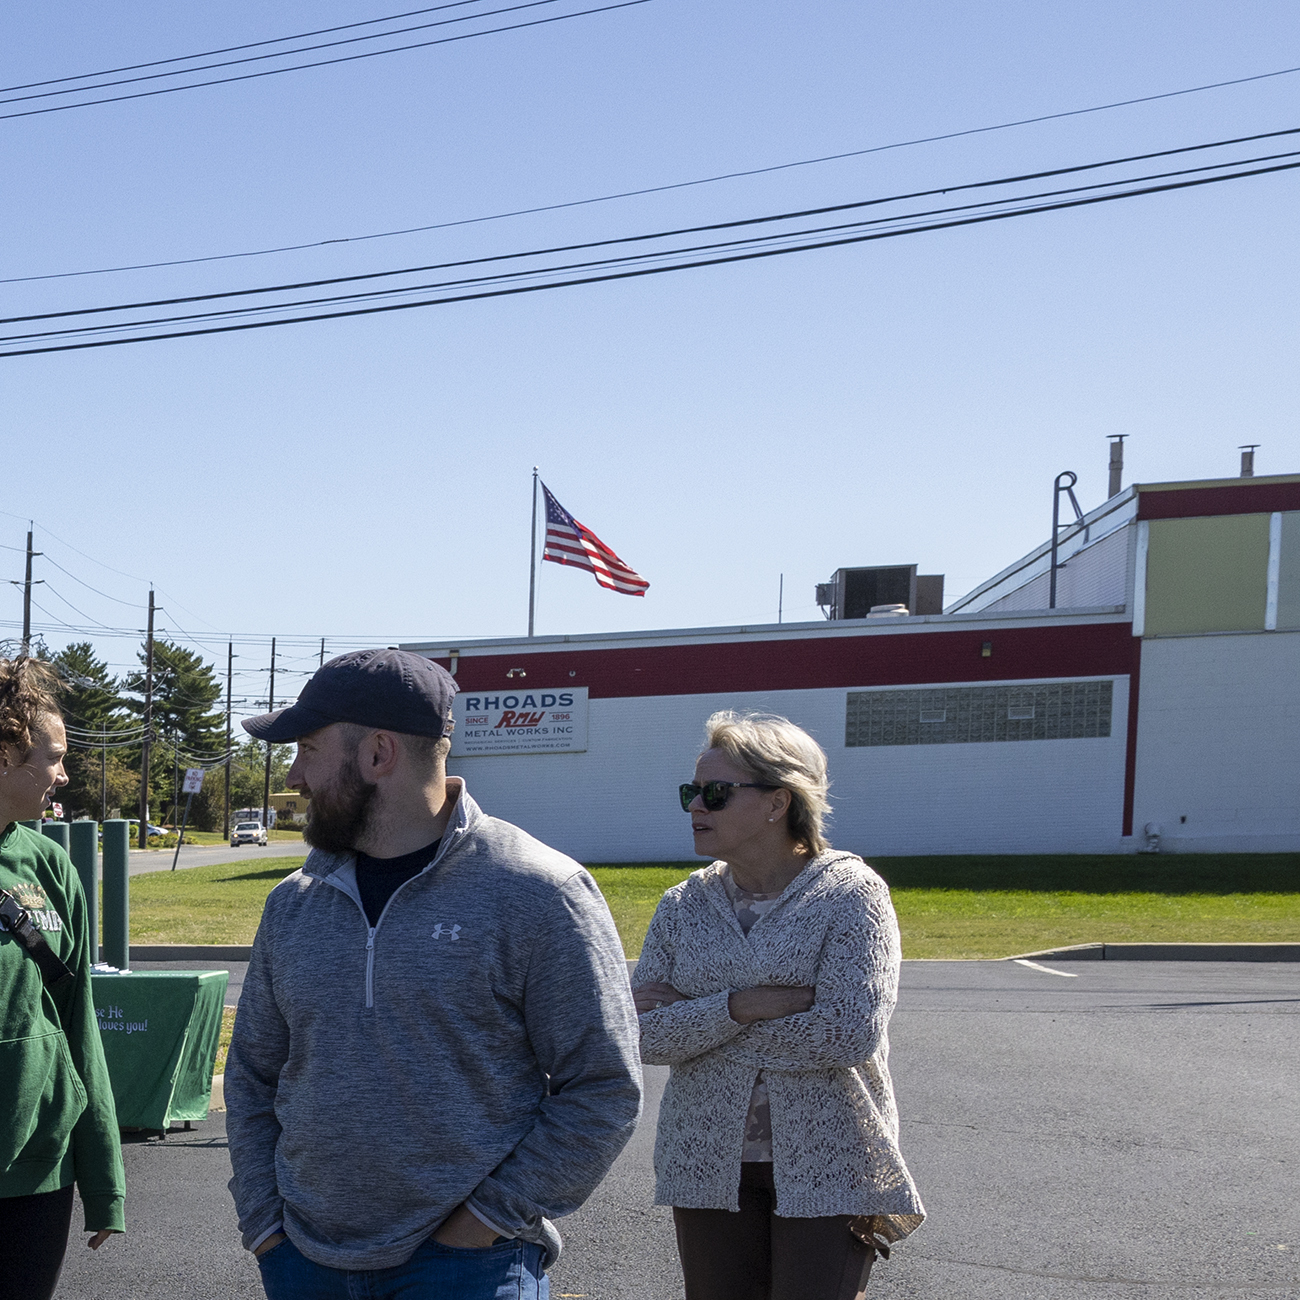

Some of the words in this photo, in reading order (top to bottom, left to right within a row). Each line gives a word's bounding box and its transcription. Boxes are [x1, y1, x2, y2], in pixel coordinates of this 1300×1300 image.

[466, 693, 574, 711] RHOADS
[465, 717, 489, 725] SINCE
[465, 730, 503, 738] METAL
[507, 727, 549, 736] WORKS
[553, 726, 573, 734] INC
[108, 1005, 124, 1019] He
[99, 1018, 125, 1031] loves
[126, 1019, 148, 1035] you!
